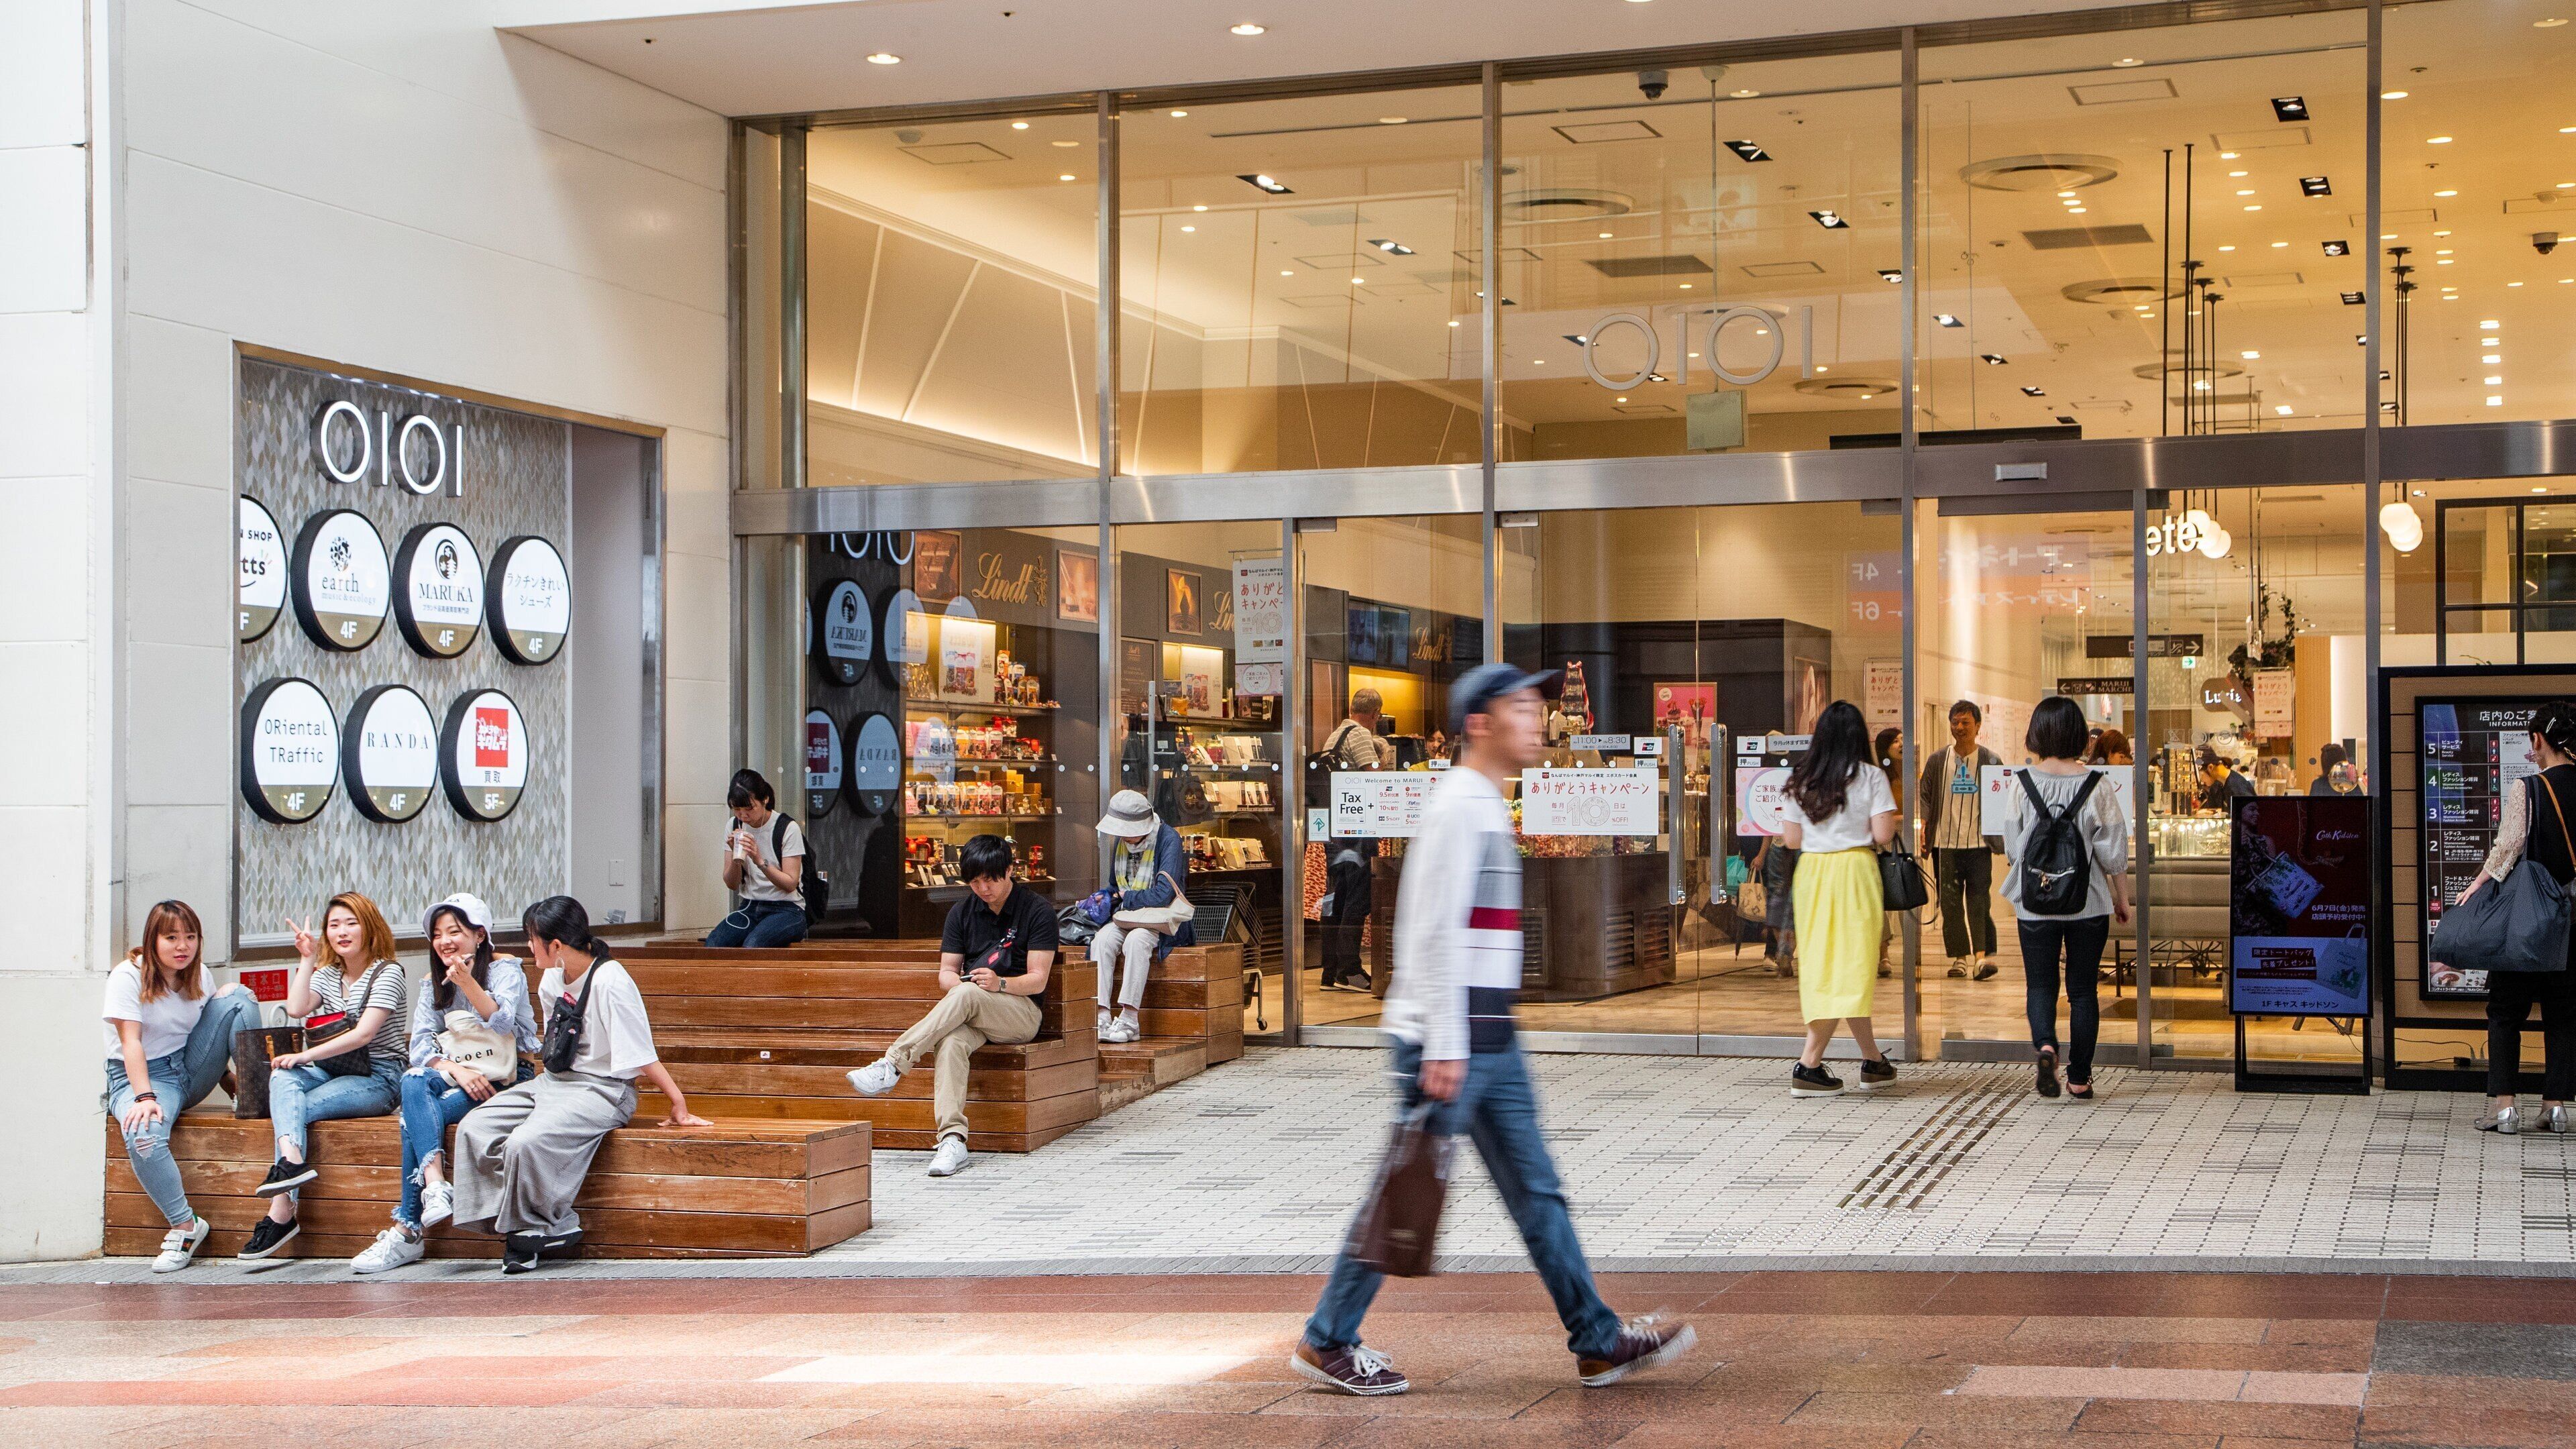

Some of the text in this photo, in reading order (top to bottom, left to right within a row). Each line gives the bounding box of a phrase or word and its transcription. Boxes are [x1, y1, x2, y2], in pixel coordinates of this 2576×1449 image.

[248, 530, 272, 541] SHOP
[322, 573, 359, 593] earth
[506, 573, 565, 592] ラクチンきれい
[971, 552, 1034, 603] Lindt
[419, 582, 474, 603] MARUKA
[519, 594, 552, 608] シューズ
[340, 621, 357, 639] 4F
[439, 630, 454, 647] 4F
[528, 638, 543, 655] 4F
[265, 719, 327, 736] ORiental
[367, 732, 429, 749] RANDA
[2428, 743, 2436, 754] 5
[270, 747, 324, 763] TRaffic
[484, 771, 501, 784] 買取
[2428, 775, 2437, 787] 4
[1531, 782, 1650, 795] ありがとうキャンペーン
[287, 792, 305, 810] 4F
[389, 793, 406, 811] 4F
[485, 793, 500, 810] 5F
[1342, 792, 1361, 803] Tax
[1340, 804, 1363, 814] Free
[1566, 796, 1611, 826] 10
[2429, 808, 2437, 819] 3
[2430, 841, 2438, 851] 2
[2431, 885, 2437, 896] 1
[2302, 1000, 2339, 1008] キッドソン
[455, 1049, 493, 1063] coen
